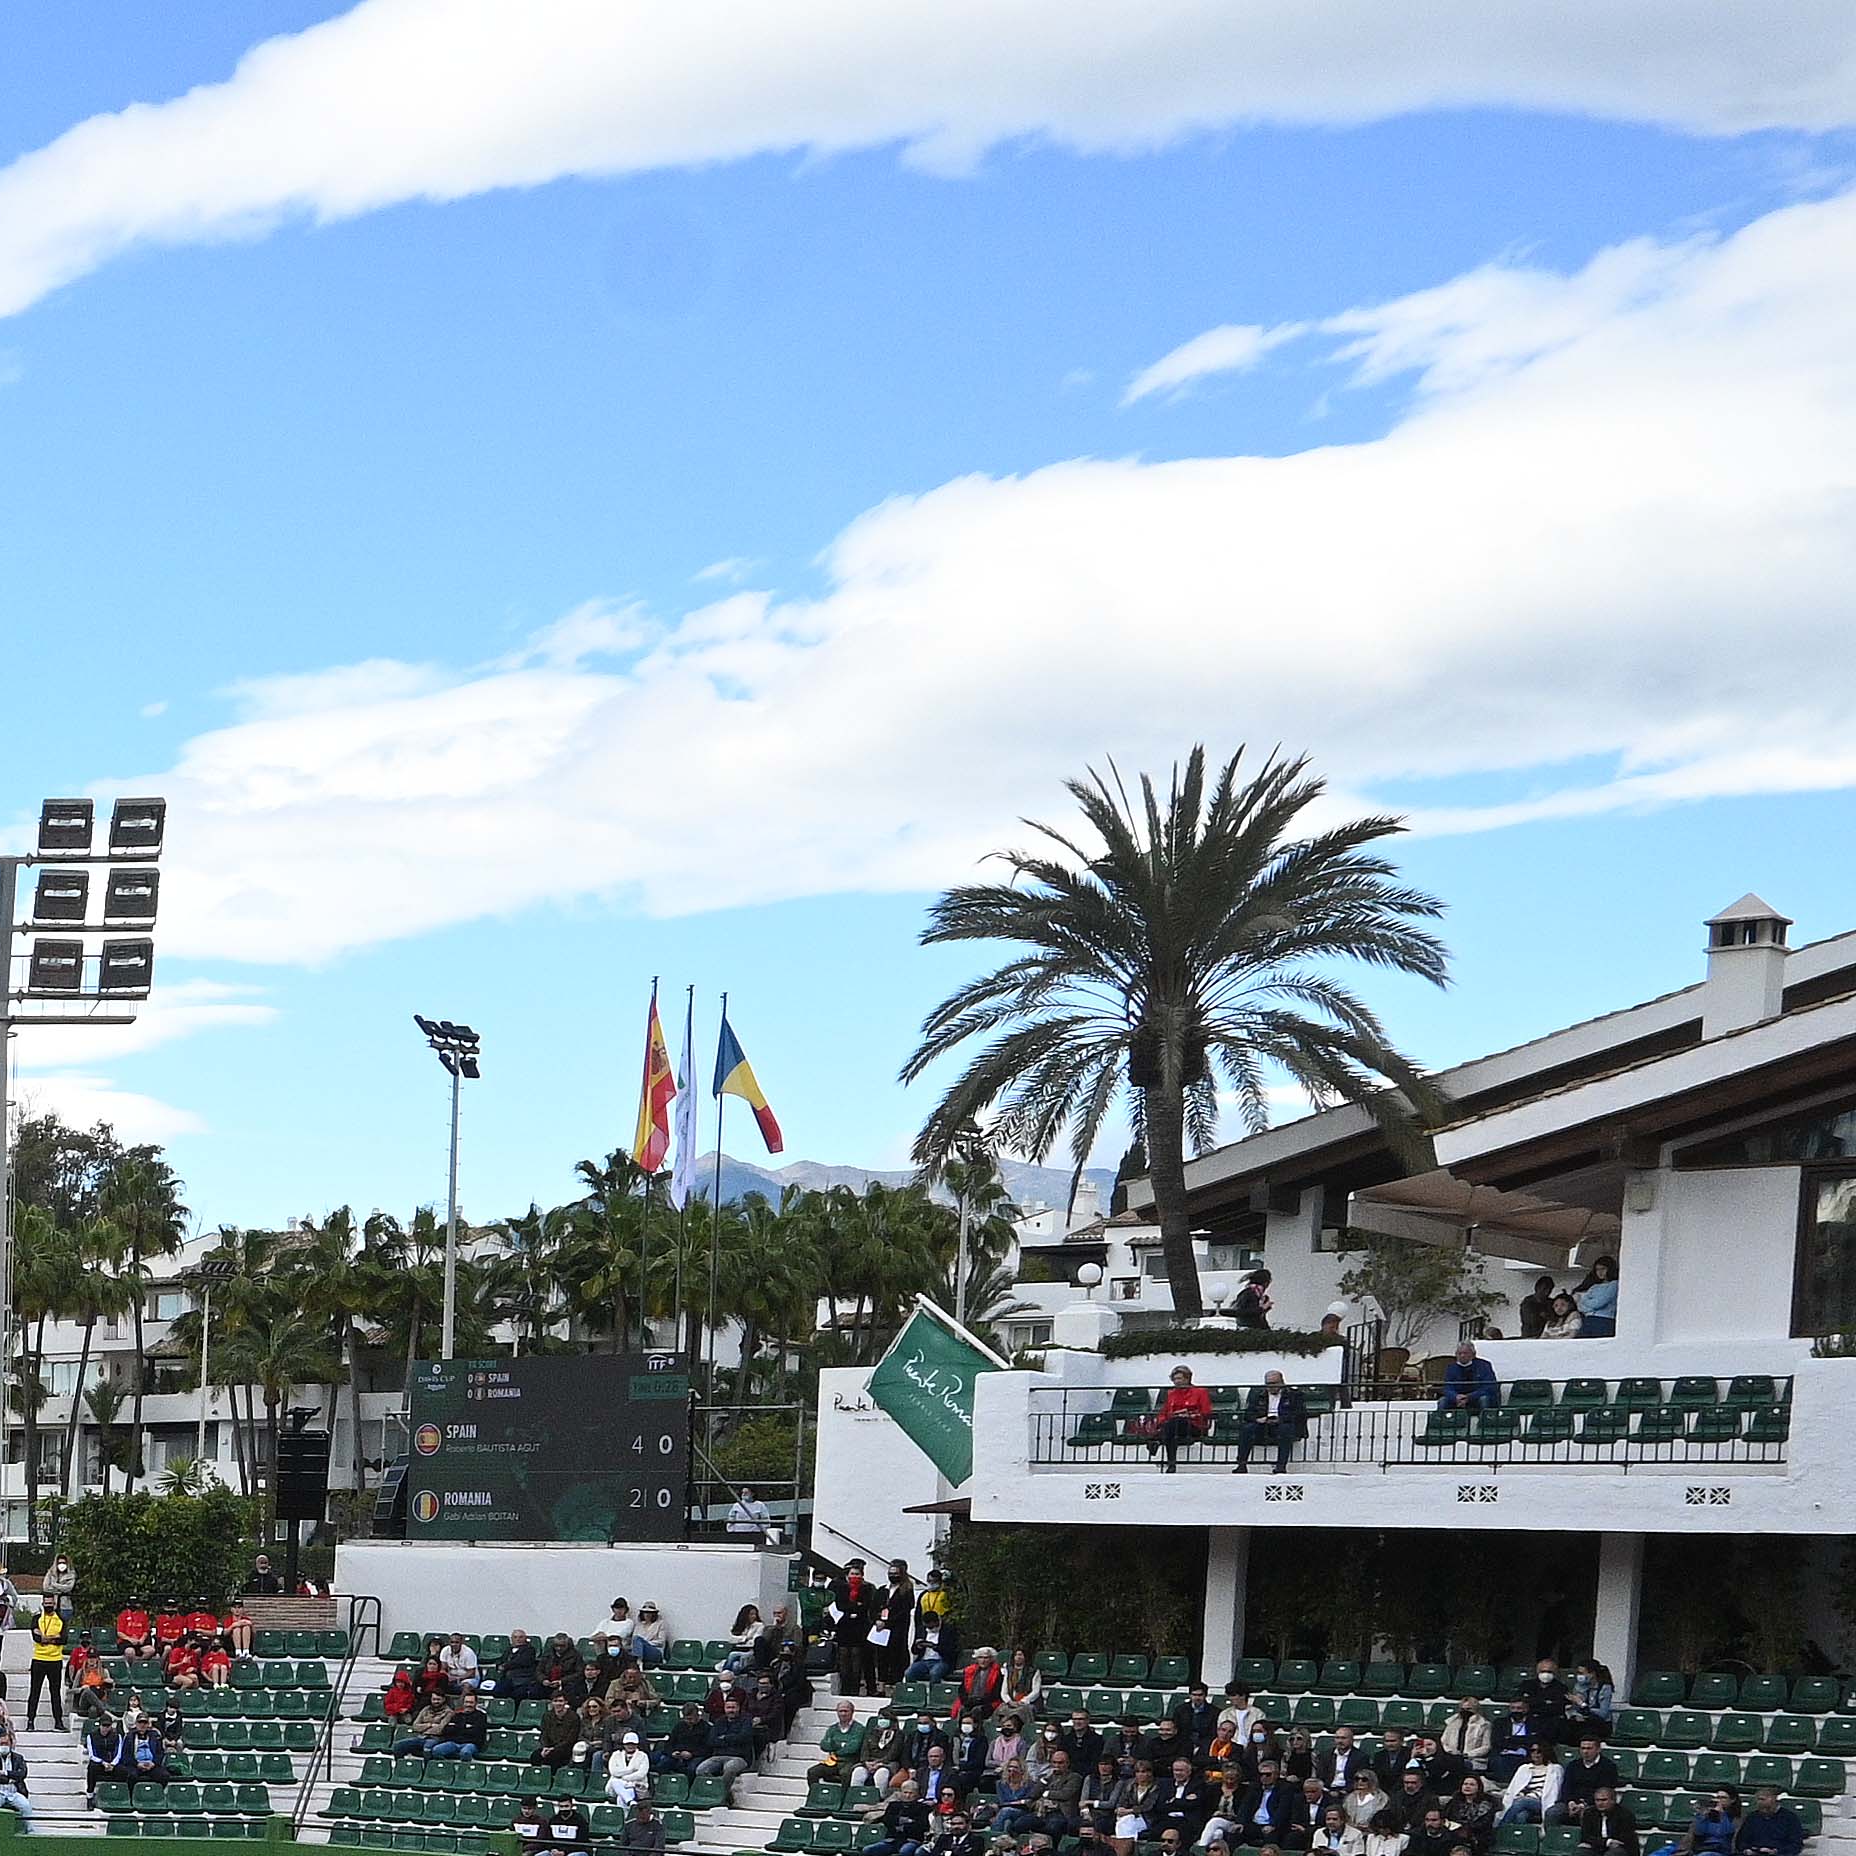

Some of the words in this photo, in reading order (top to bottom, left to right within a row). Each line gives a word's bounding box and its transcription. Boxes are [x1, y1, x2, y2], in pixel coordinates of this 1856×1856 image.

[648, 1359, 667, 1371] ITF
[488, 1372, 510, 1383] SPAIN
[487, 1388, 521, 1398] ROMANIA
[446, 1424, 477, 1439] SPAIN
[631, 1434, 644, 1454] 4
[659, 1434, 674, 1455] 0
[444, 1491, 492, 1506] ROMANIA
[629, 1488, 642, 1508] 2
[656, 1488, 672, 1508] 0
